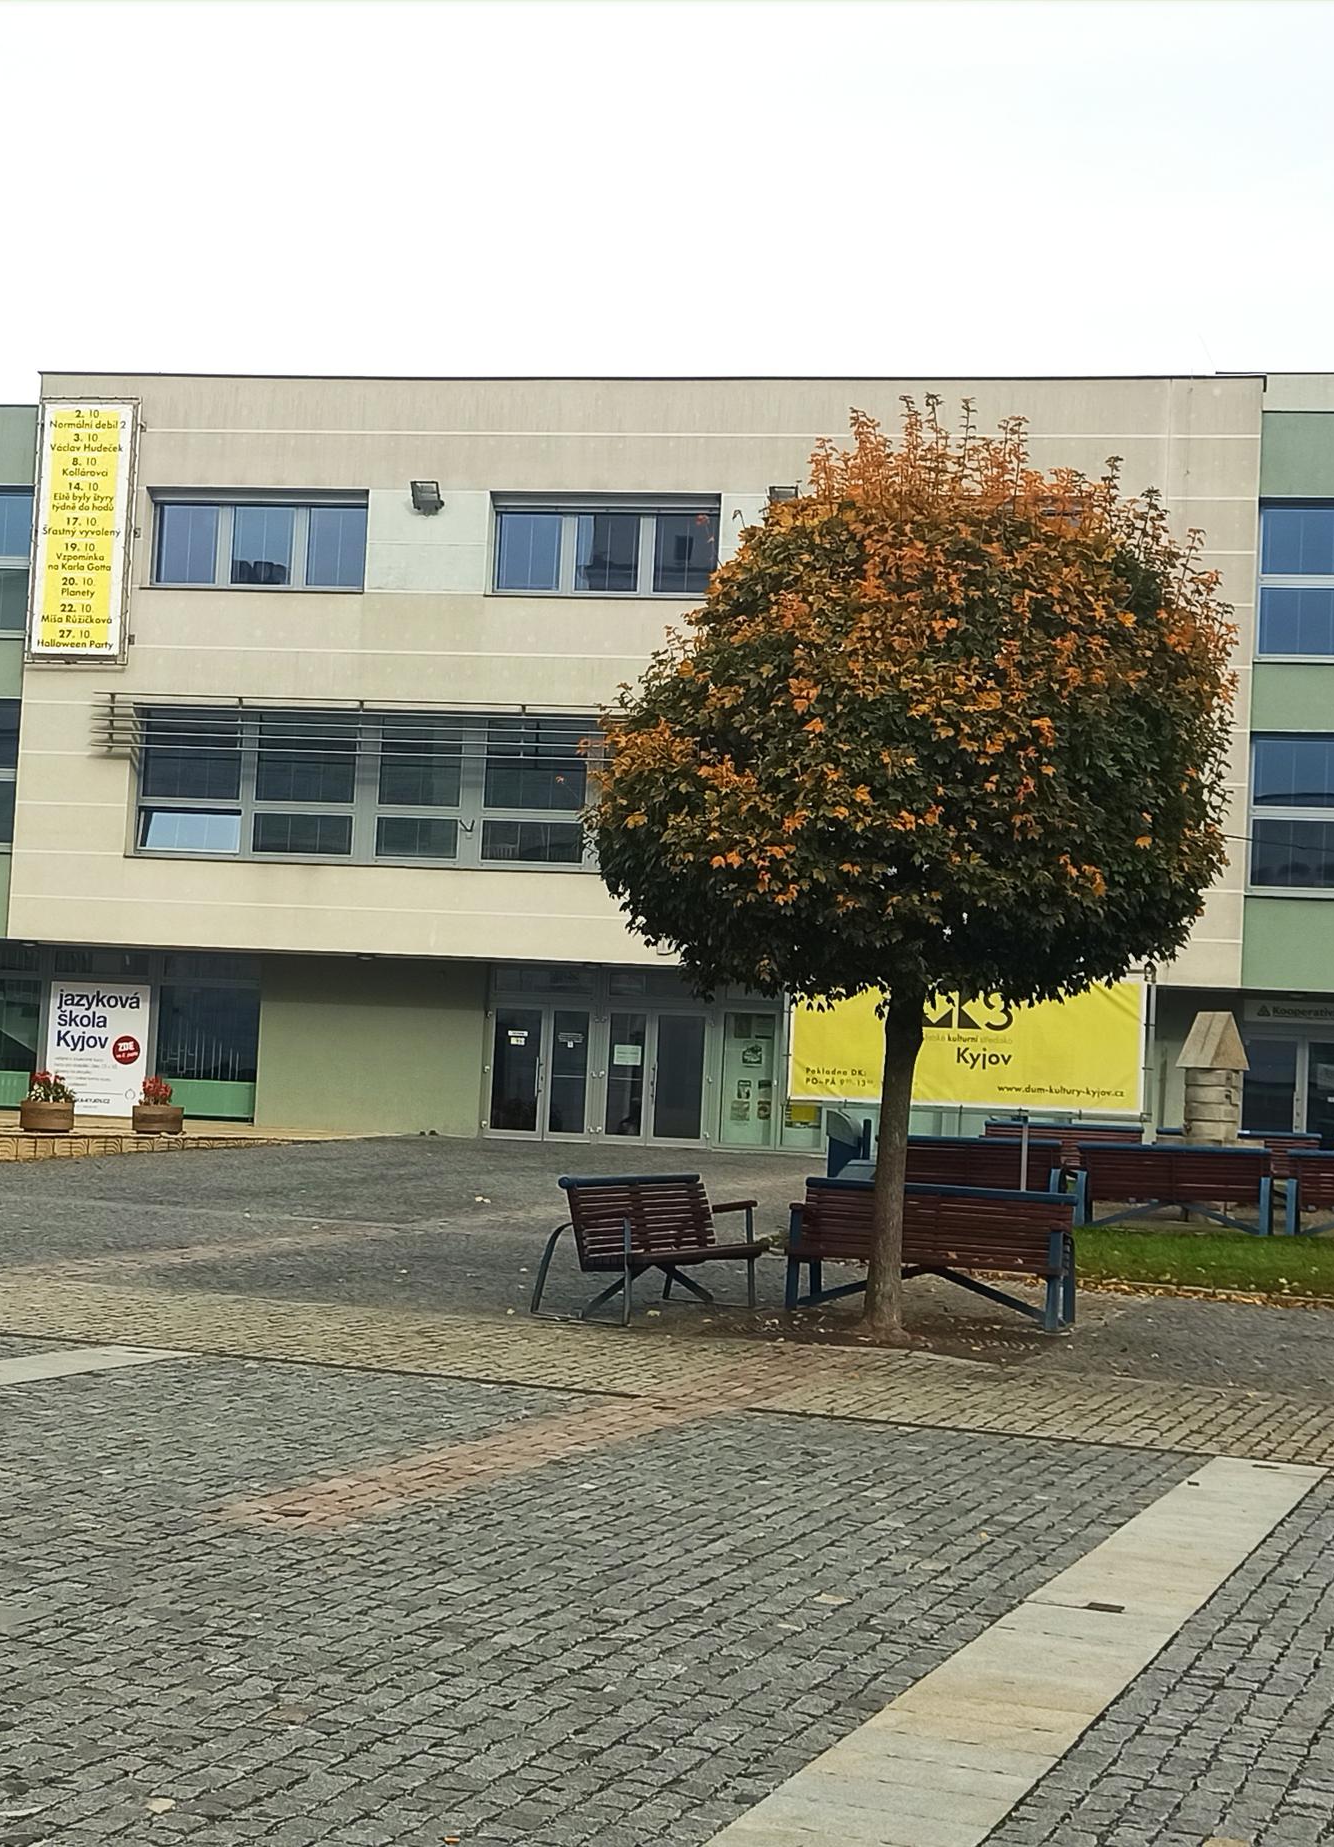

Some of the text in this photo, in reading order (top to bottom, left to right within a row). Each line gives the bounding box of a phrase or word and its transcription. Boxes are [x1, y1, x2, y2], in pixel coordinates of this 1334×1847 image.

[75, 410, 85, 419] 2.
[49, 420, 127, 430] Normální debil 2
[73, 433, 83, 442] 3.
[49, 443, 124, 453] Václav Hudeček
[71, 458, 82, 466] 8.
[62, 468, 109, 477] Kollárovci
[68, 482, 84, 491] 14.
[72, 492, 90, 503] byly
[93, 493, 115, 503] štyry
[79, 502, 89, 511] do
[91, 502, 115, 511] hodů
[66, 517, 82, 526] 17.
[79, 527, 121, 538] vyvolený
[65, 543, 80, 552] 19.
[61, 562, 85, 572] Karla
[87, 563, 112, 572] Gotta
[62, 577, 79, 586] 20.
[61, 588, 96, 599] Planety
[60, 604, 77, 613] 22.
[59, 629, 76, 639] 27.
[37, 639, 114, 650] Halloween Party
[57, 989, 140, 1011] jazyková
[57, 1009, 108, 1029] škola
[56, 1030, 109, 1052] Kyjov
[947, 1033, 979, 1043] kulturní
[956, 1047, 1013, 1070] Kyjov
[805, 1067, 848, 1076] Pokladna
[997, 1084, 1125, 1098] www.dum-kultury-kyjov.cz
